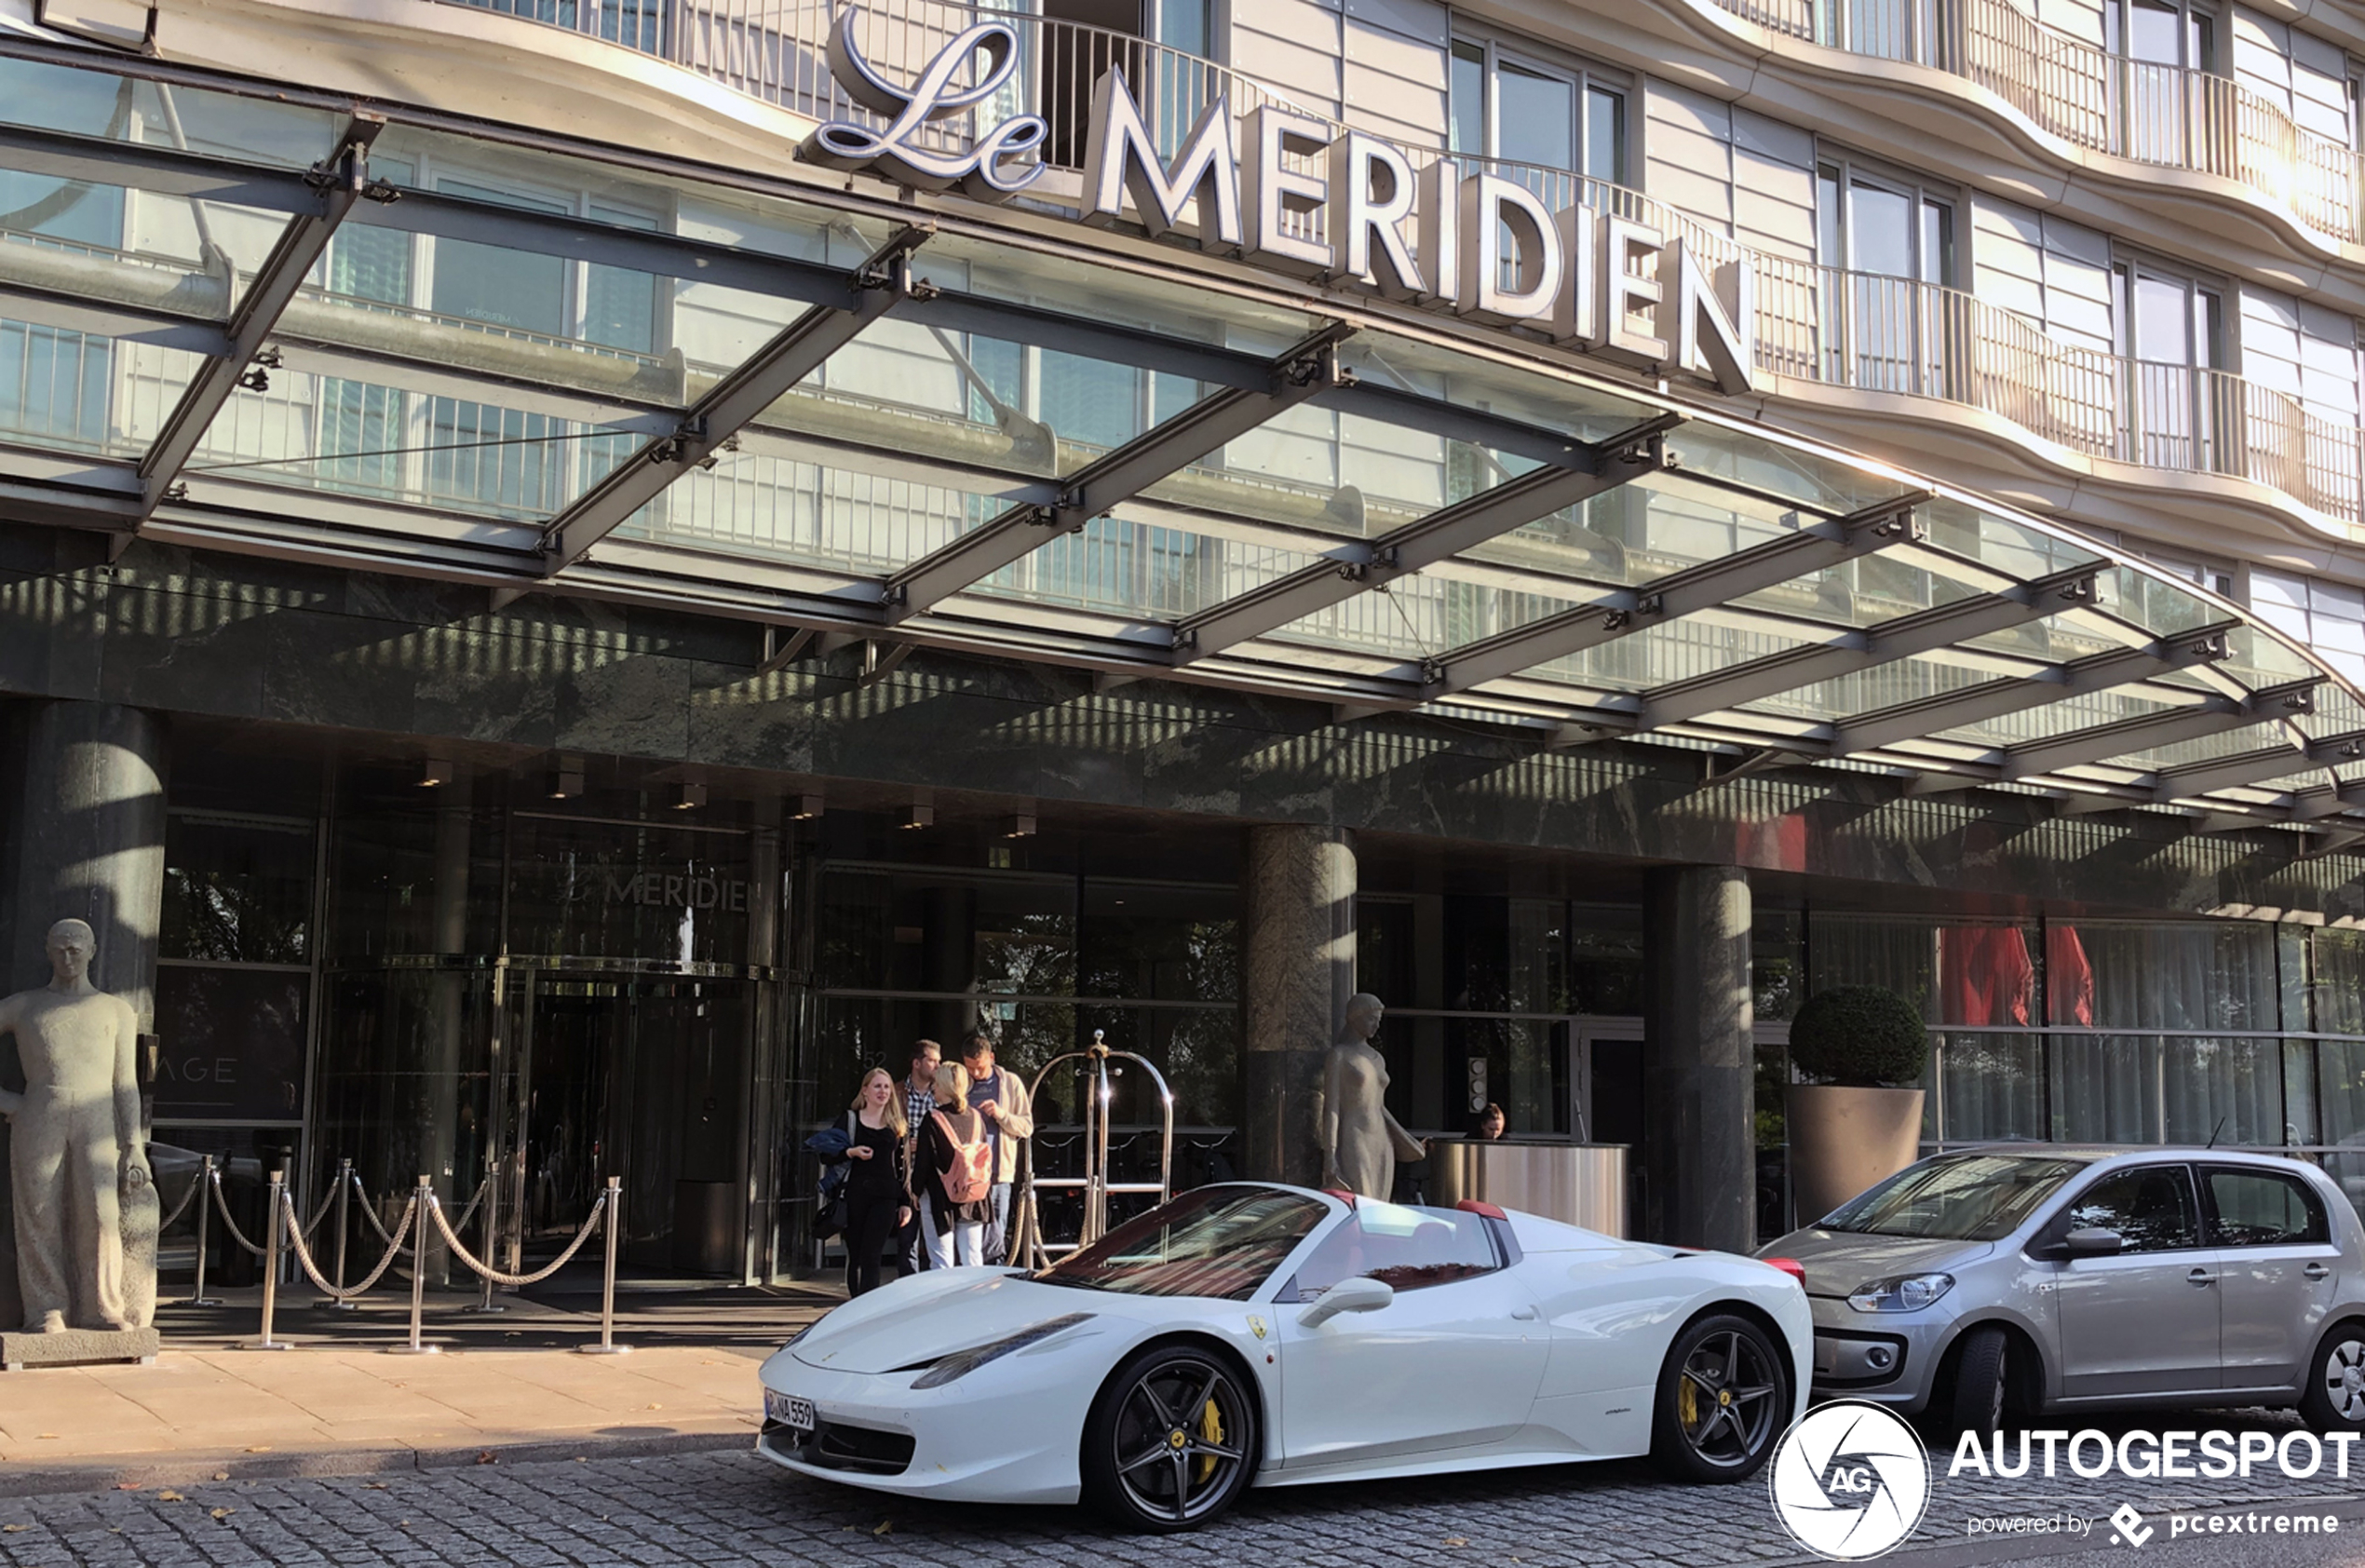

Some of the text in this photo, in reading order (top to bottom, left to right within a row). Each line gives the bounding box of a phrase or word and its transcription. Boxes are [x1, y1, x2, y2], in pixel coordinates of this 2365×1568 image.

[815, 5, 1755, 395] Le MERIDIEN
[604, 872, 752, 913] MERIDIE
[791, 1400, 811, 1426] 559
